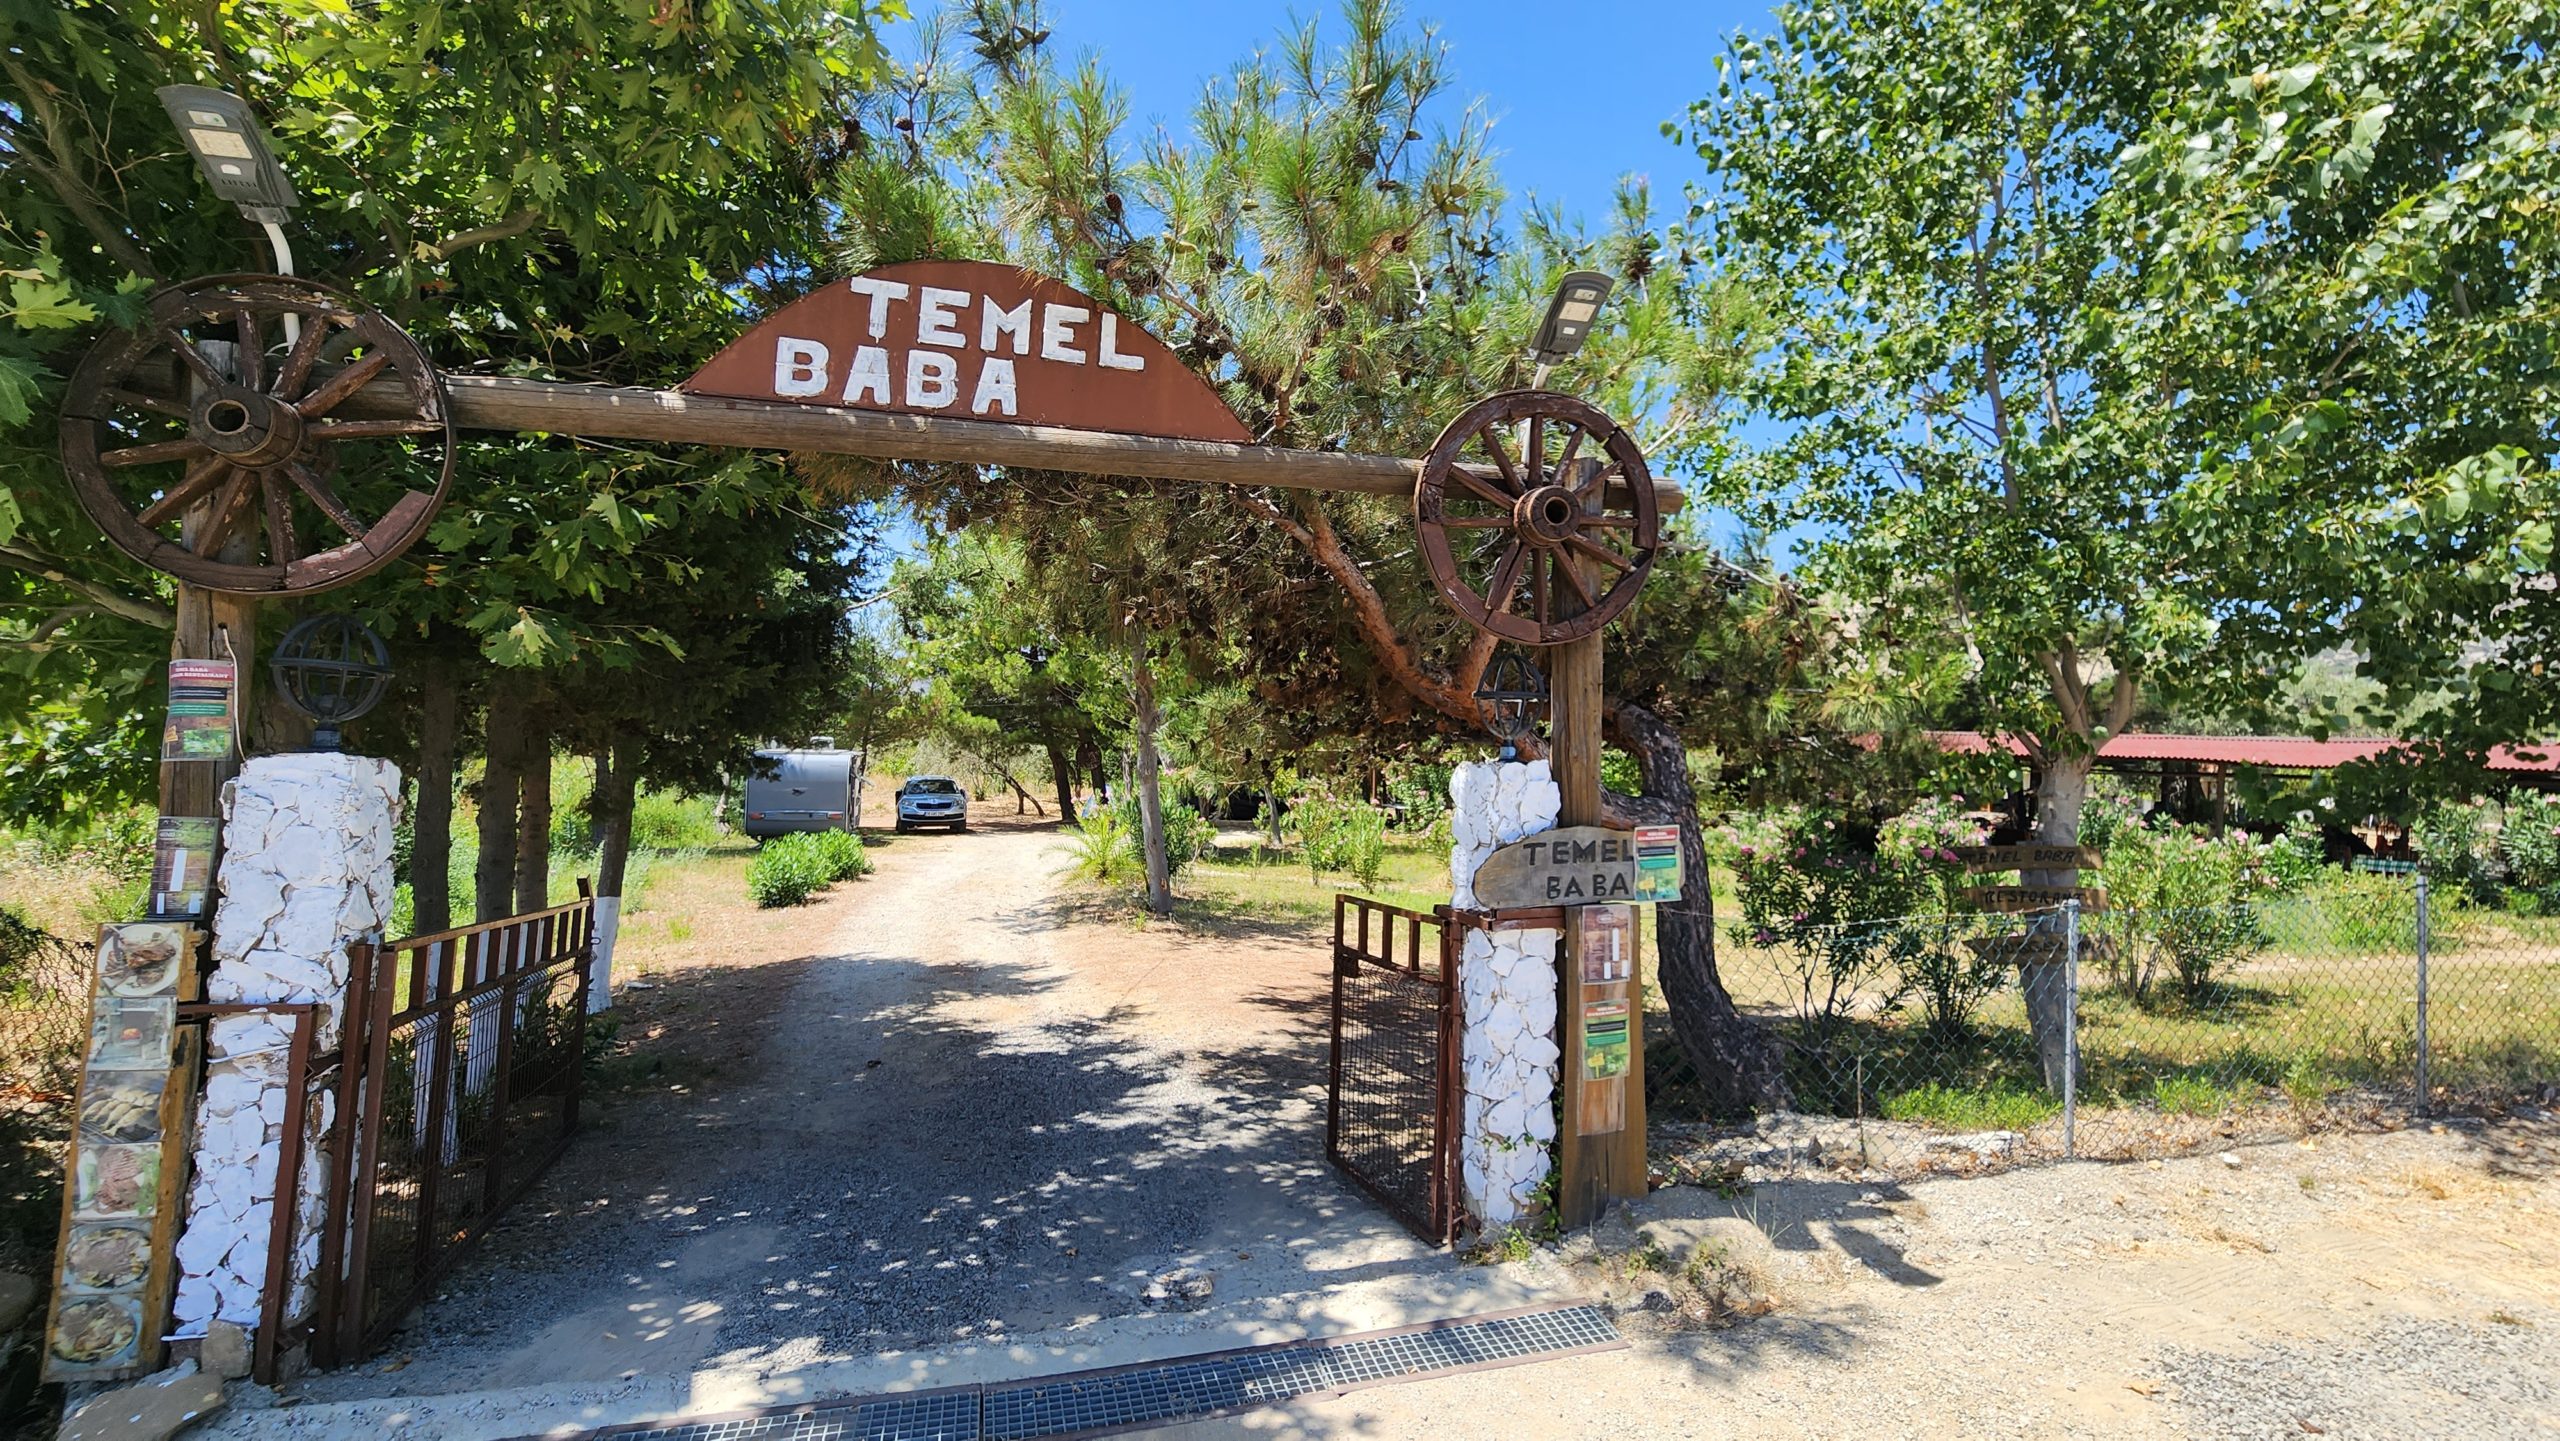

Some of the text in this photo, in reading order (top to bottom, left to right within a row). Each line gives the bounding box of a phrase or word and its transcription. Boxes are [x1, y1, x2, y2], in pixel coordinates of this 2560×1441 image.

[850, 275, 1146, 371] TEMEL
[774, 336, 1018, 416] BABA
[1523, 839, 1633, 866] TEMEL
[2034, 849, 2076, 862] BABA
[1546, 873, 1629, 899] BABA
